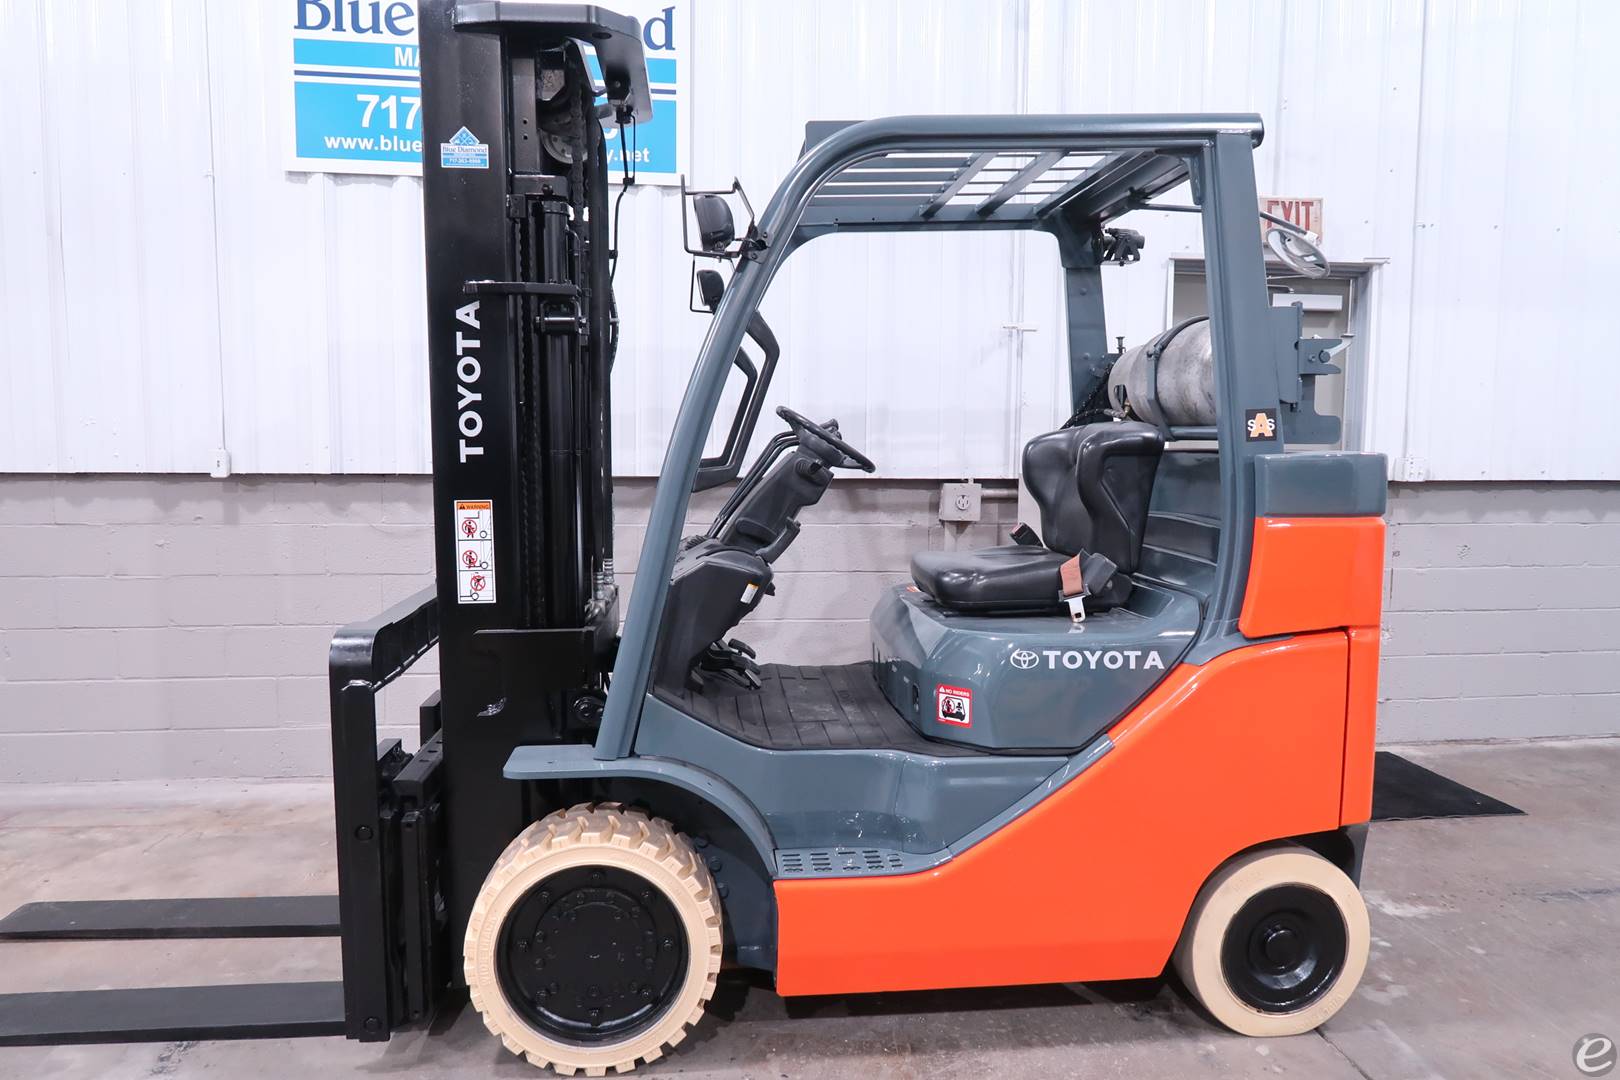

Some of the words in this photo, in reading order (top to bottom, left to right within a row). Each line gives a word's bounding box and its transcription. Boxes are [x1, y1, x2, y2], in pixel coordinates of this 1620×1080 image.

[294, 0, 415, 36] Blue
[456, 300, 484, 463] TOYOTA
[1043, 650, 1165, 670] TOYOTA
